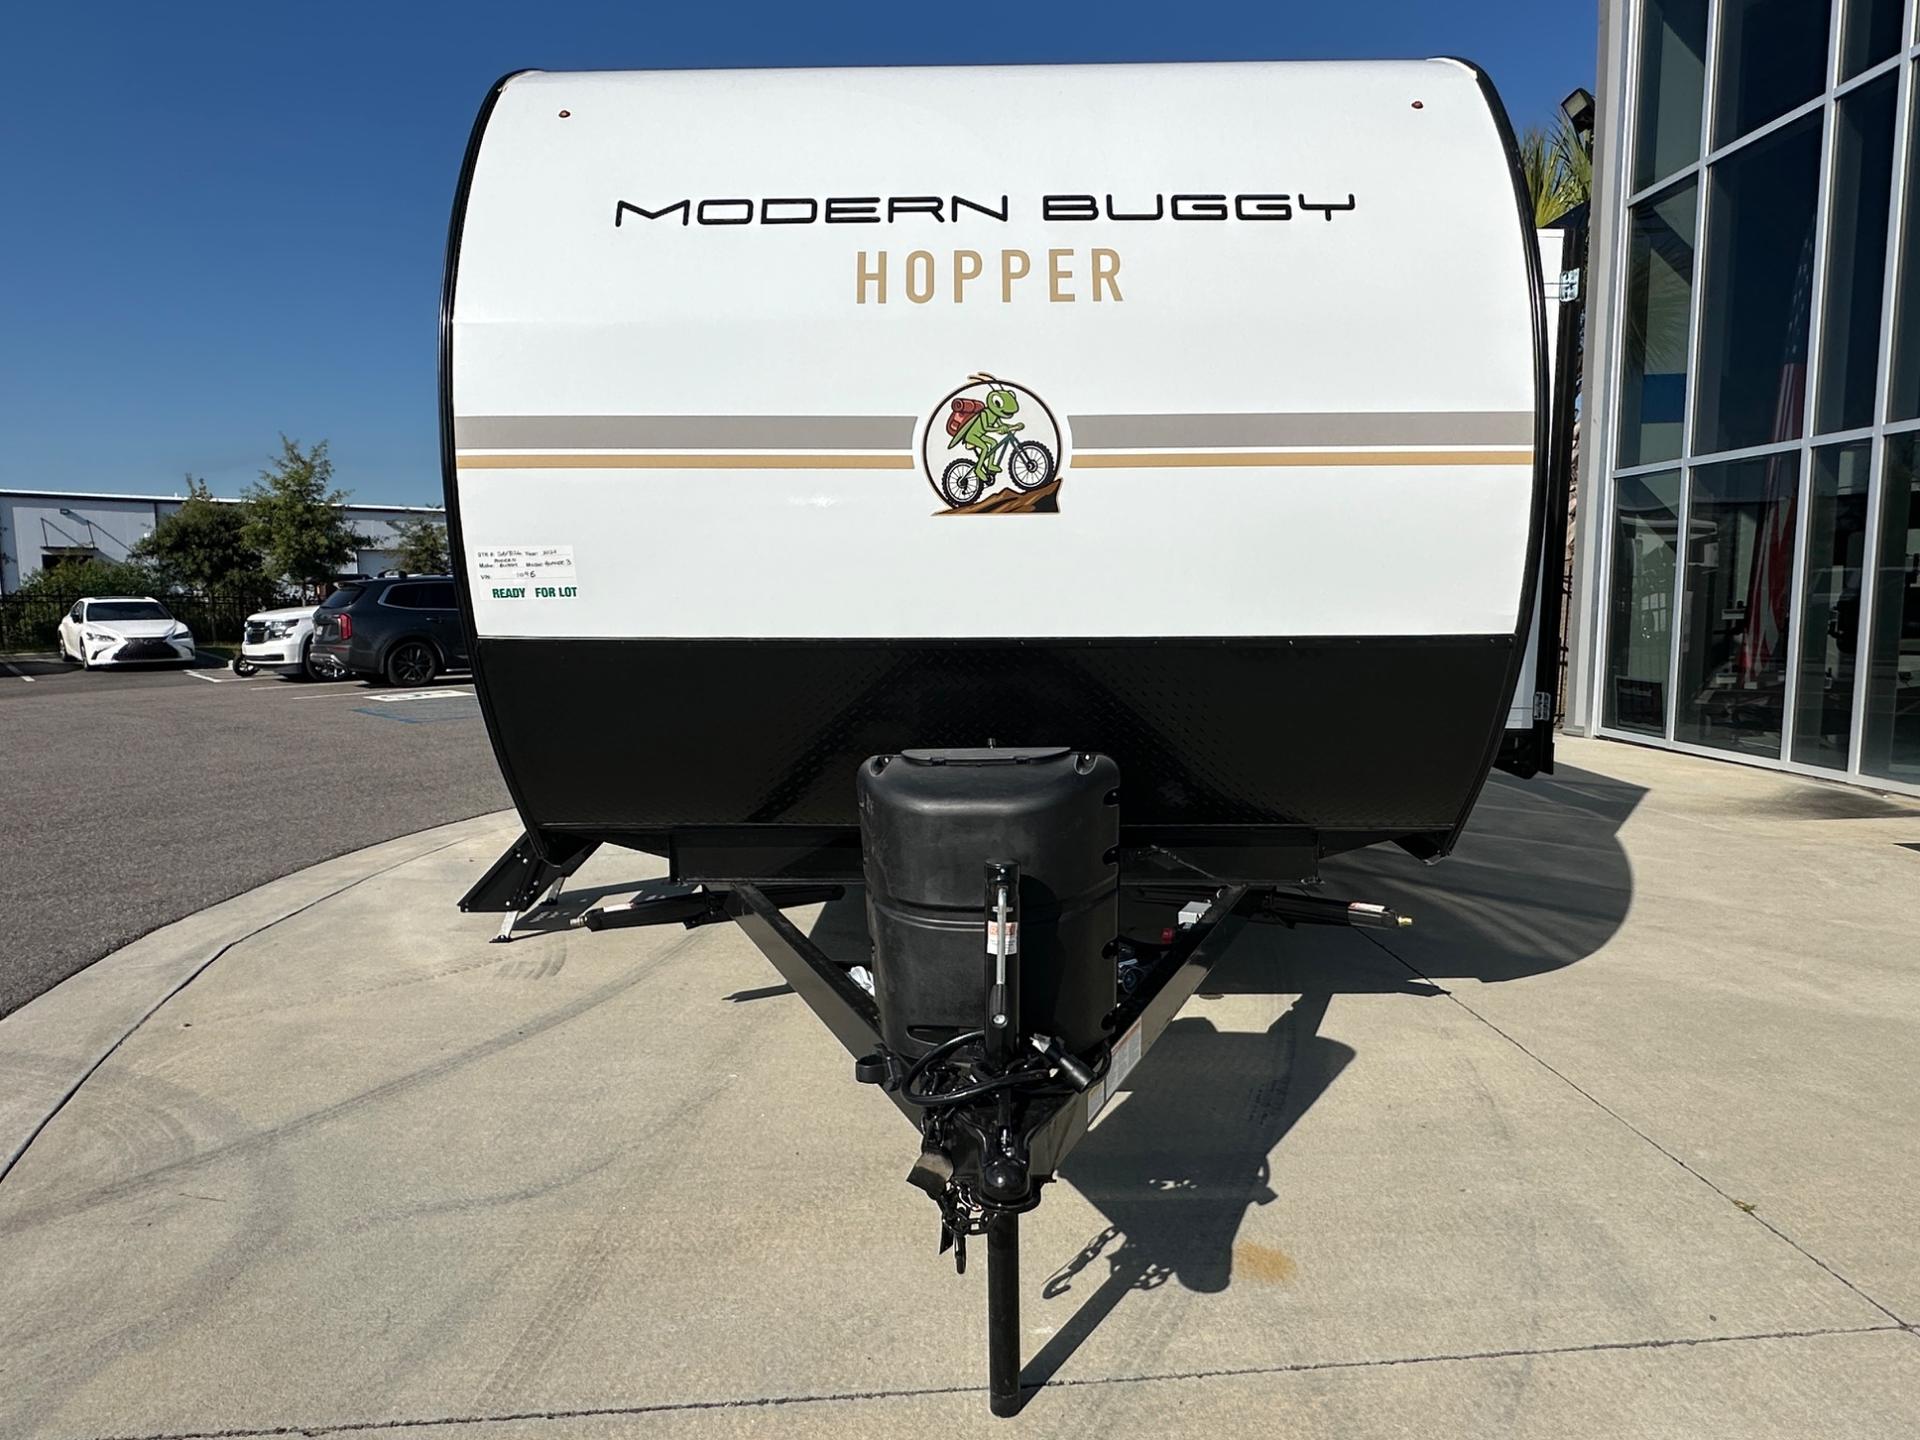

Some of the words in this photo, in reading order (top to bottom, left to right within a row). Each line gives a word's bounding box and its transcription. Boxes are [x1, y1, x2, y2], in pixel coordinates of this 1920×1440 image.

[616, 194, 1009, 227] MODERN
[1043, 193, 1356, 222] BUGGY
[857, 249, 1122, 304] HOPPER
[492, 588, 525, 598] READY
[535, 587, 556, 598] FOR
[559, 587, 577, 597] LOT
